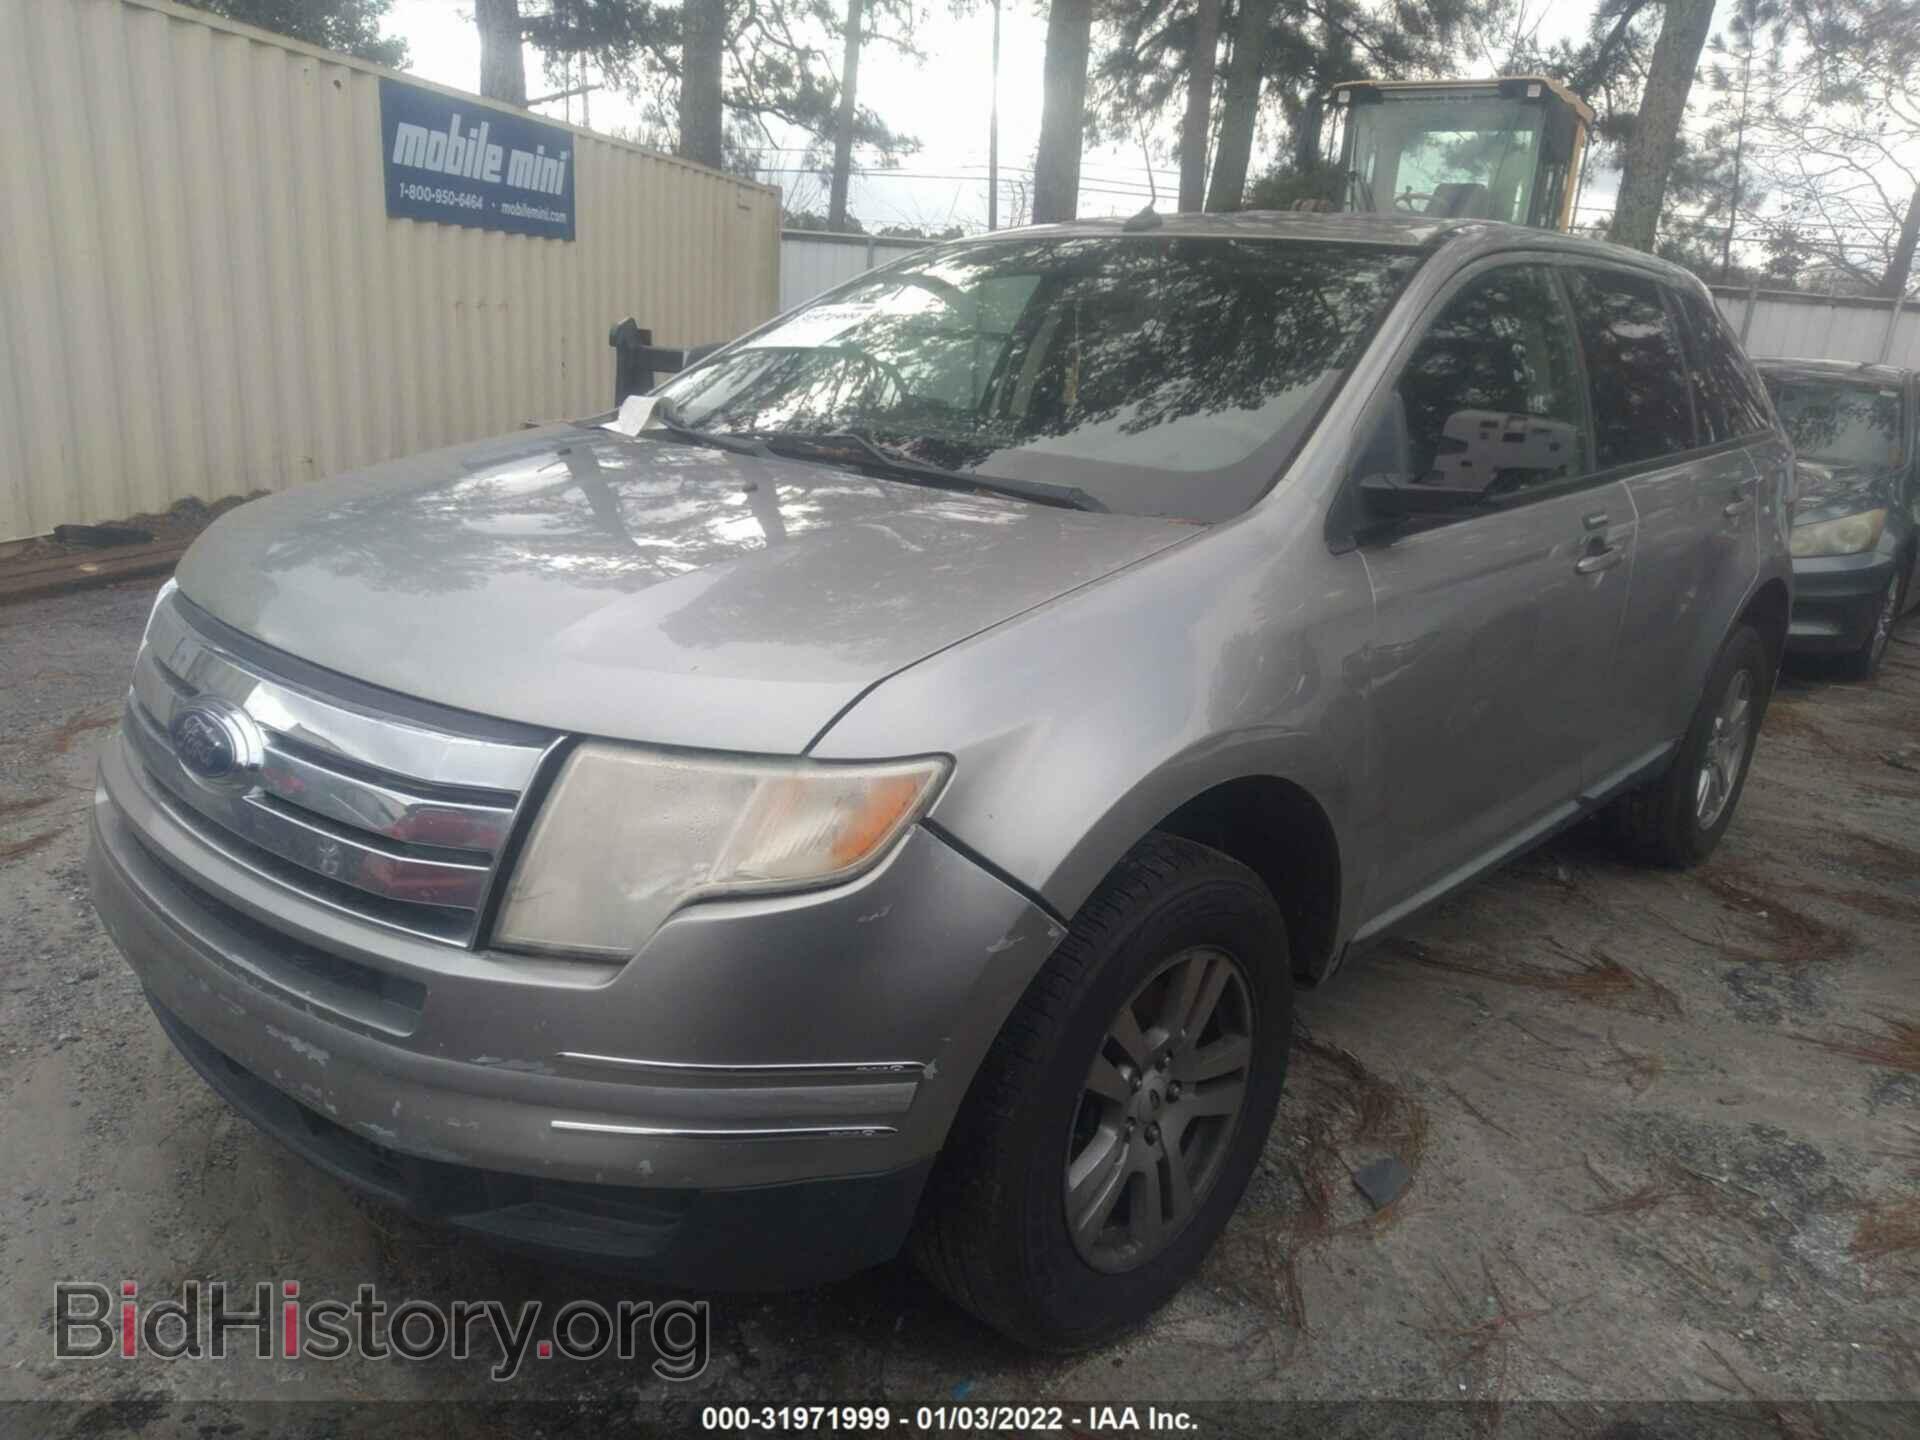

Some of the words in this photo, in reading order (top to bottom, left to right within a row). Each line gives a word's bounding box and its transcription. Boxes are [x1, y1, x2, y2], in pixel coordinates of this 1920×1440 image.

[392, 113, 503, 183] mobile
[506, 144, 569, 196] mini
[500, 201, 567, 224] mobilemini.com
